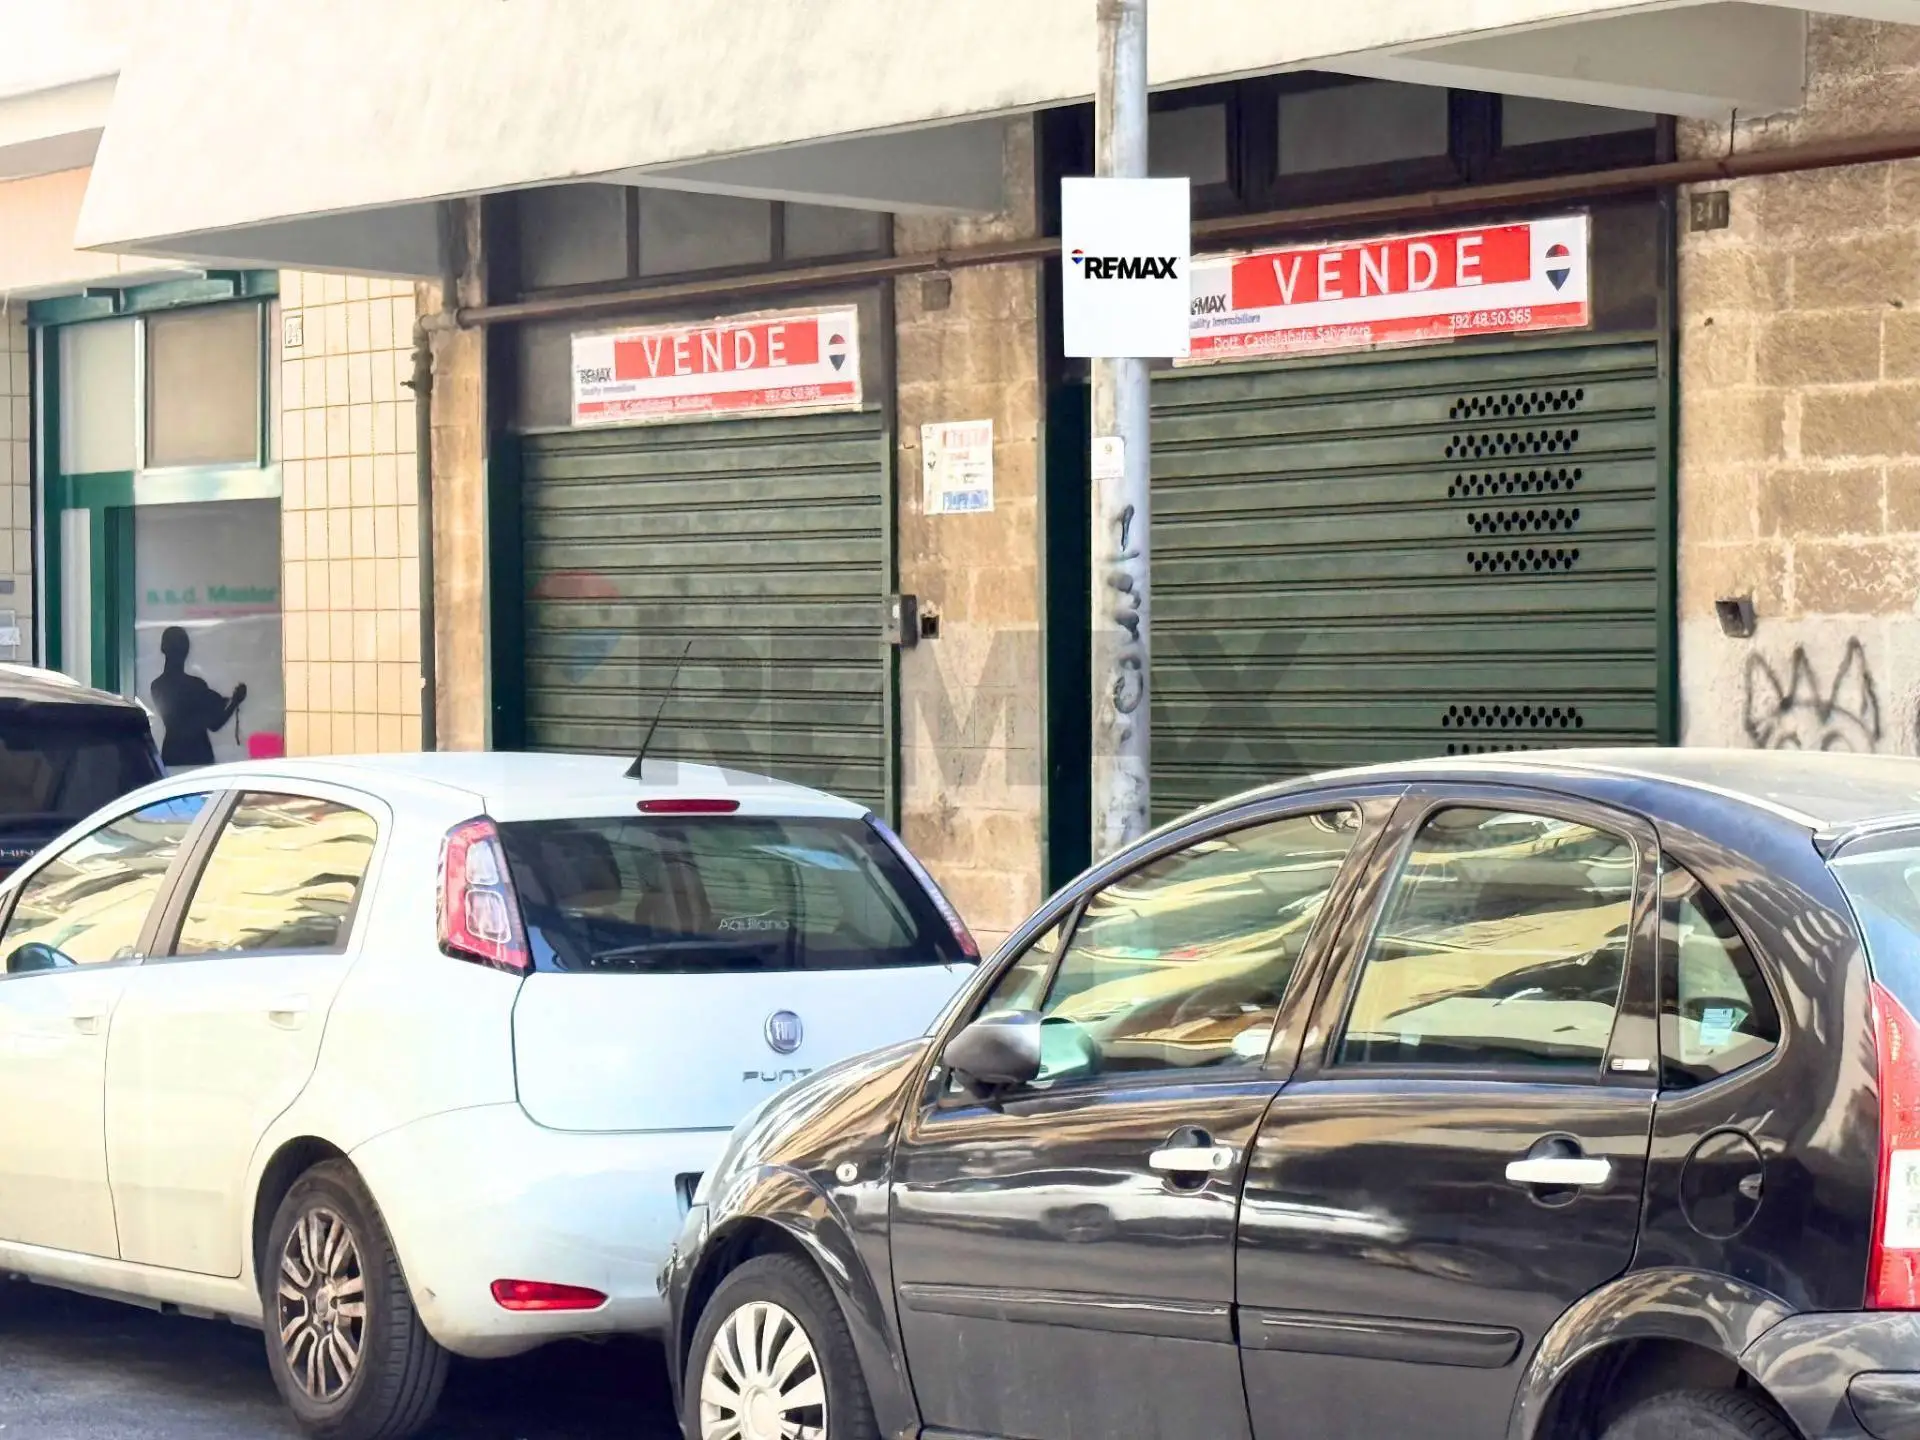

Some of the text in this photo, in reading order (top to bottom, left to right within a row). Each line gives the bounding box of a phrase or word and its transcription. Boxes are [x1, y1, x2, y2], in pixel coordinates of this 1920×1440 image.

[1084, 257, 1178, 280] REMAX
[1272, 235, 1483, 305] VENDE
[641, 325, 788, 378] VENDE
[742, 1067, 813, 1084] PUNT
